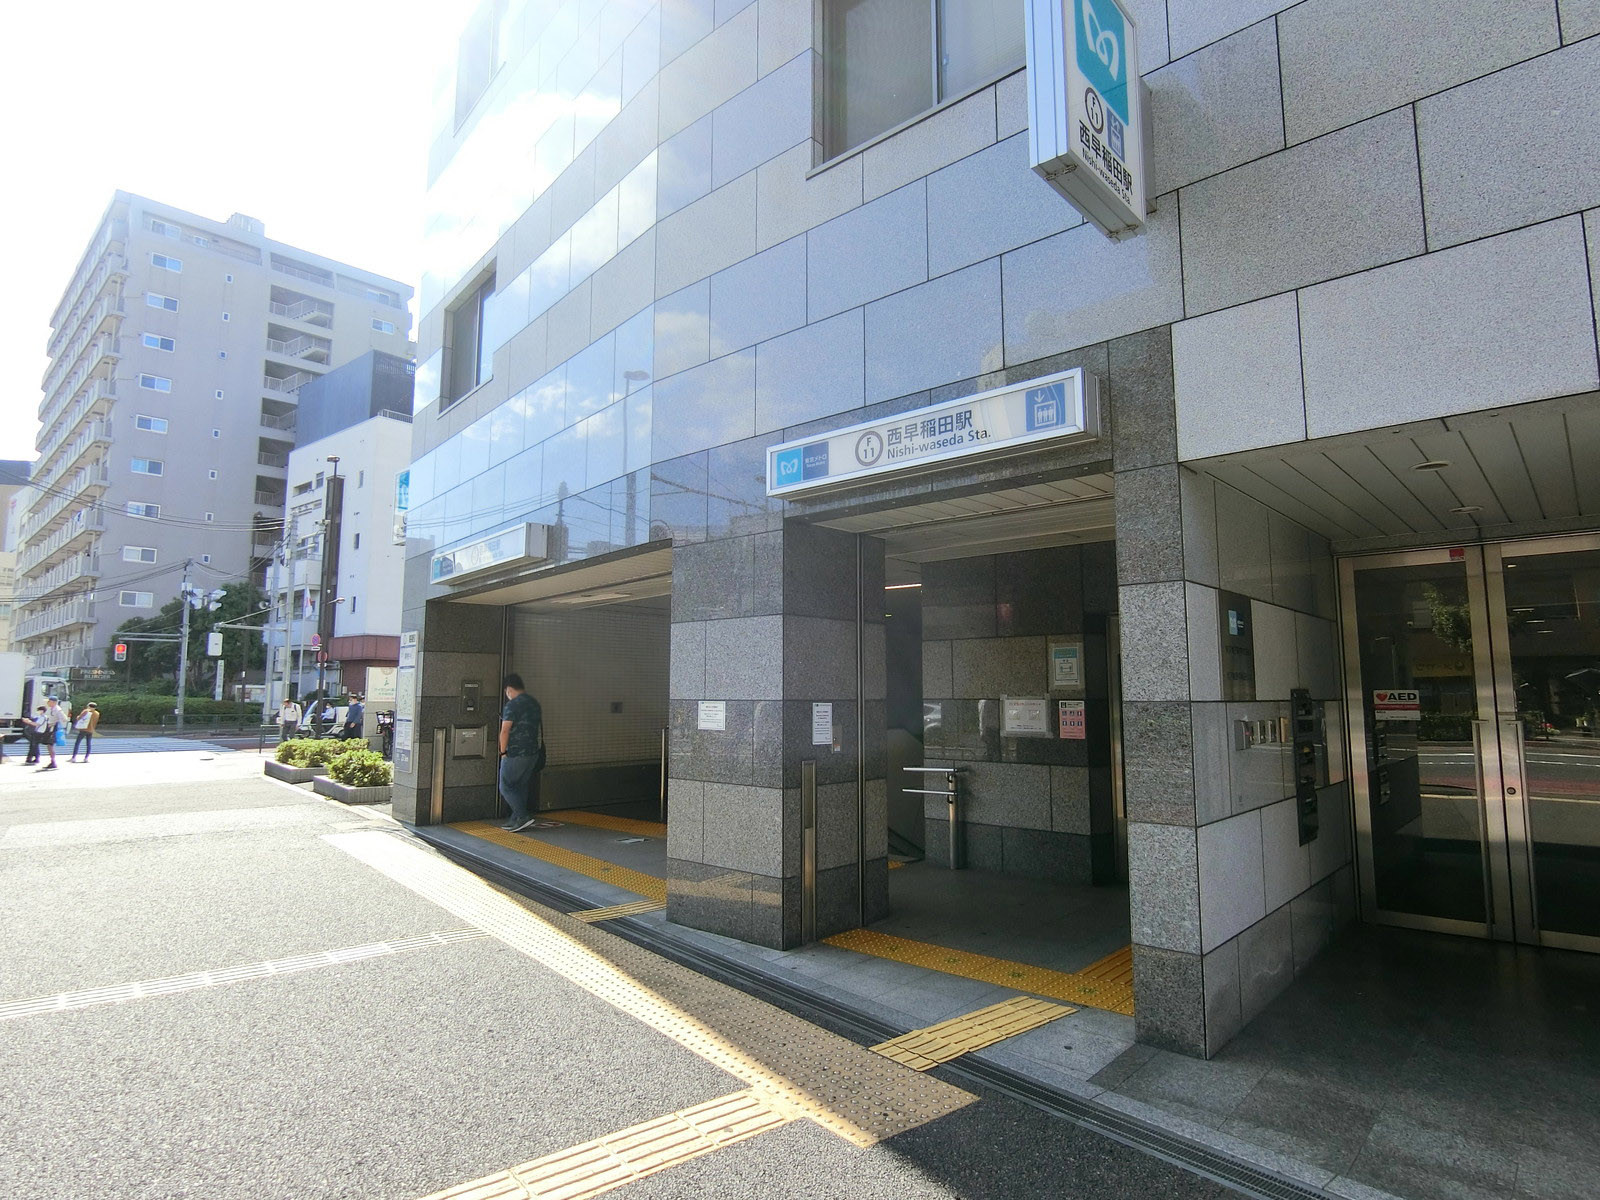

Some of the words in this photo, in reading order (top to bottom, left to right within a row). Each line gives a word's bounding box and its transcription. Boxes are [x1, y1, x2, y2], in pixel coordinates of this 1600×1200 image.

[1090, 107, 1099, 126] 11
[1078, 119, 1133, 196] 西早稲田駅
[1082, 148, 1121, 195] Nishi-waseda
[1121, 188, 1132, 207] Sta.
[887, 409, 973, 447] 西早稲田駅
[863, 447, 876, 460] 11
[866, 437, 872, 447] F
[887, 435, 964, 460] Nishi-waseda
[967, 429, 991, 443] Sta.
[1387, 692, 1417, 701] AED
